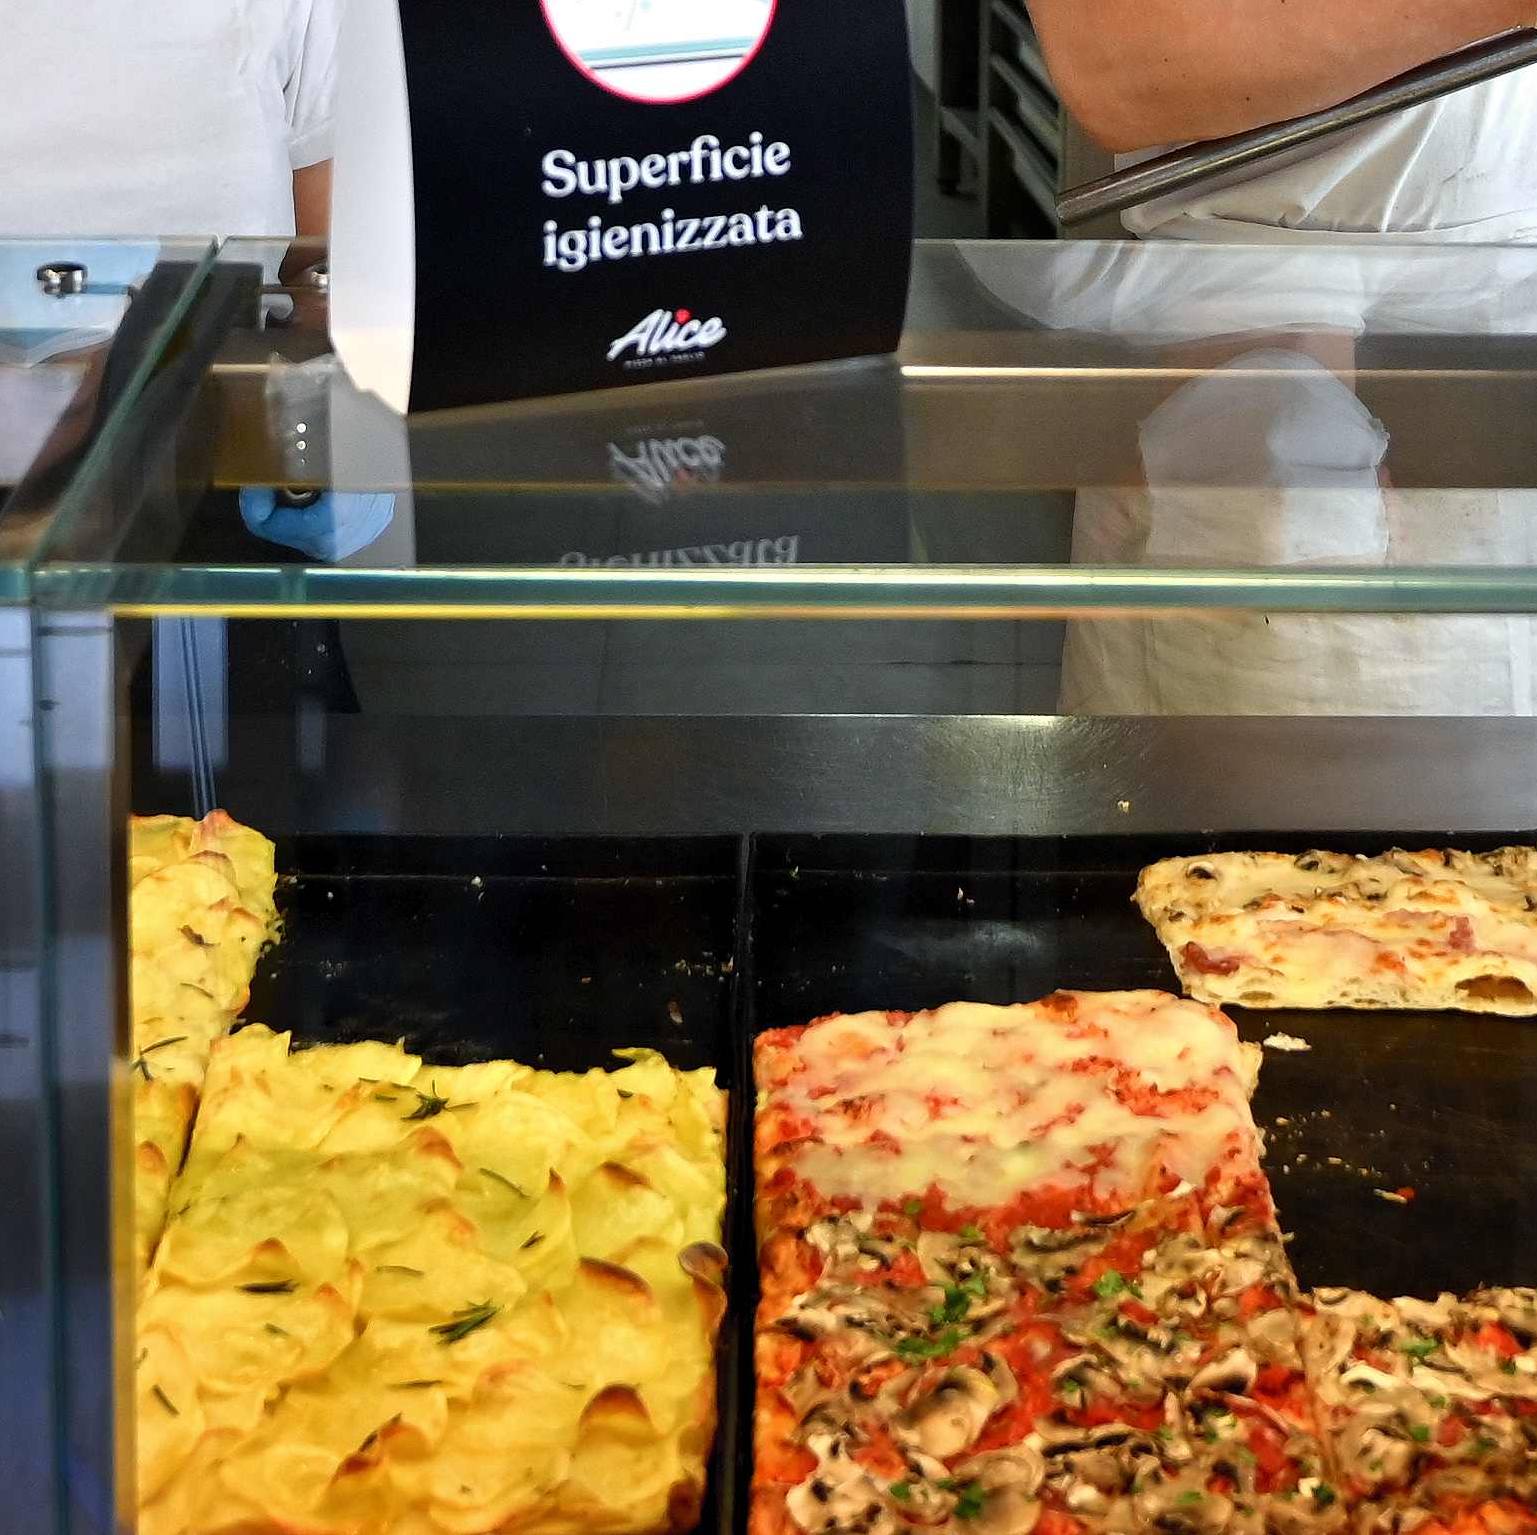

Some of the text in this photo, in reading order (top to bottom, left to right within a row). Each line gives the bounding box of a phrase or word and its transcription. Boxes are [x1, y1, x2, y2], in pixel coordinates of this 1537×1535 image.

[541, 131, 791, 204] Superficie
[542, 203, 803, 271] igienizzata
[606, 308, 727, 362] Alice
